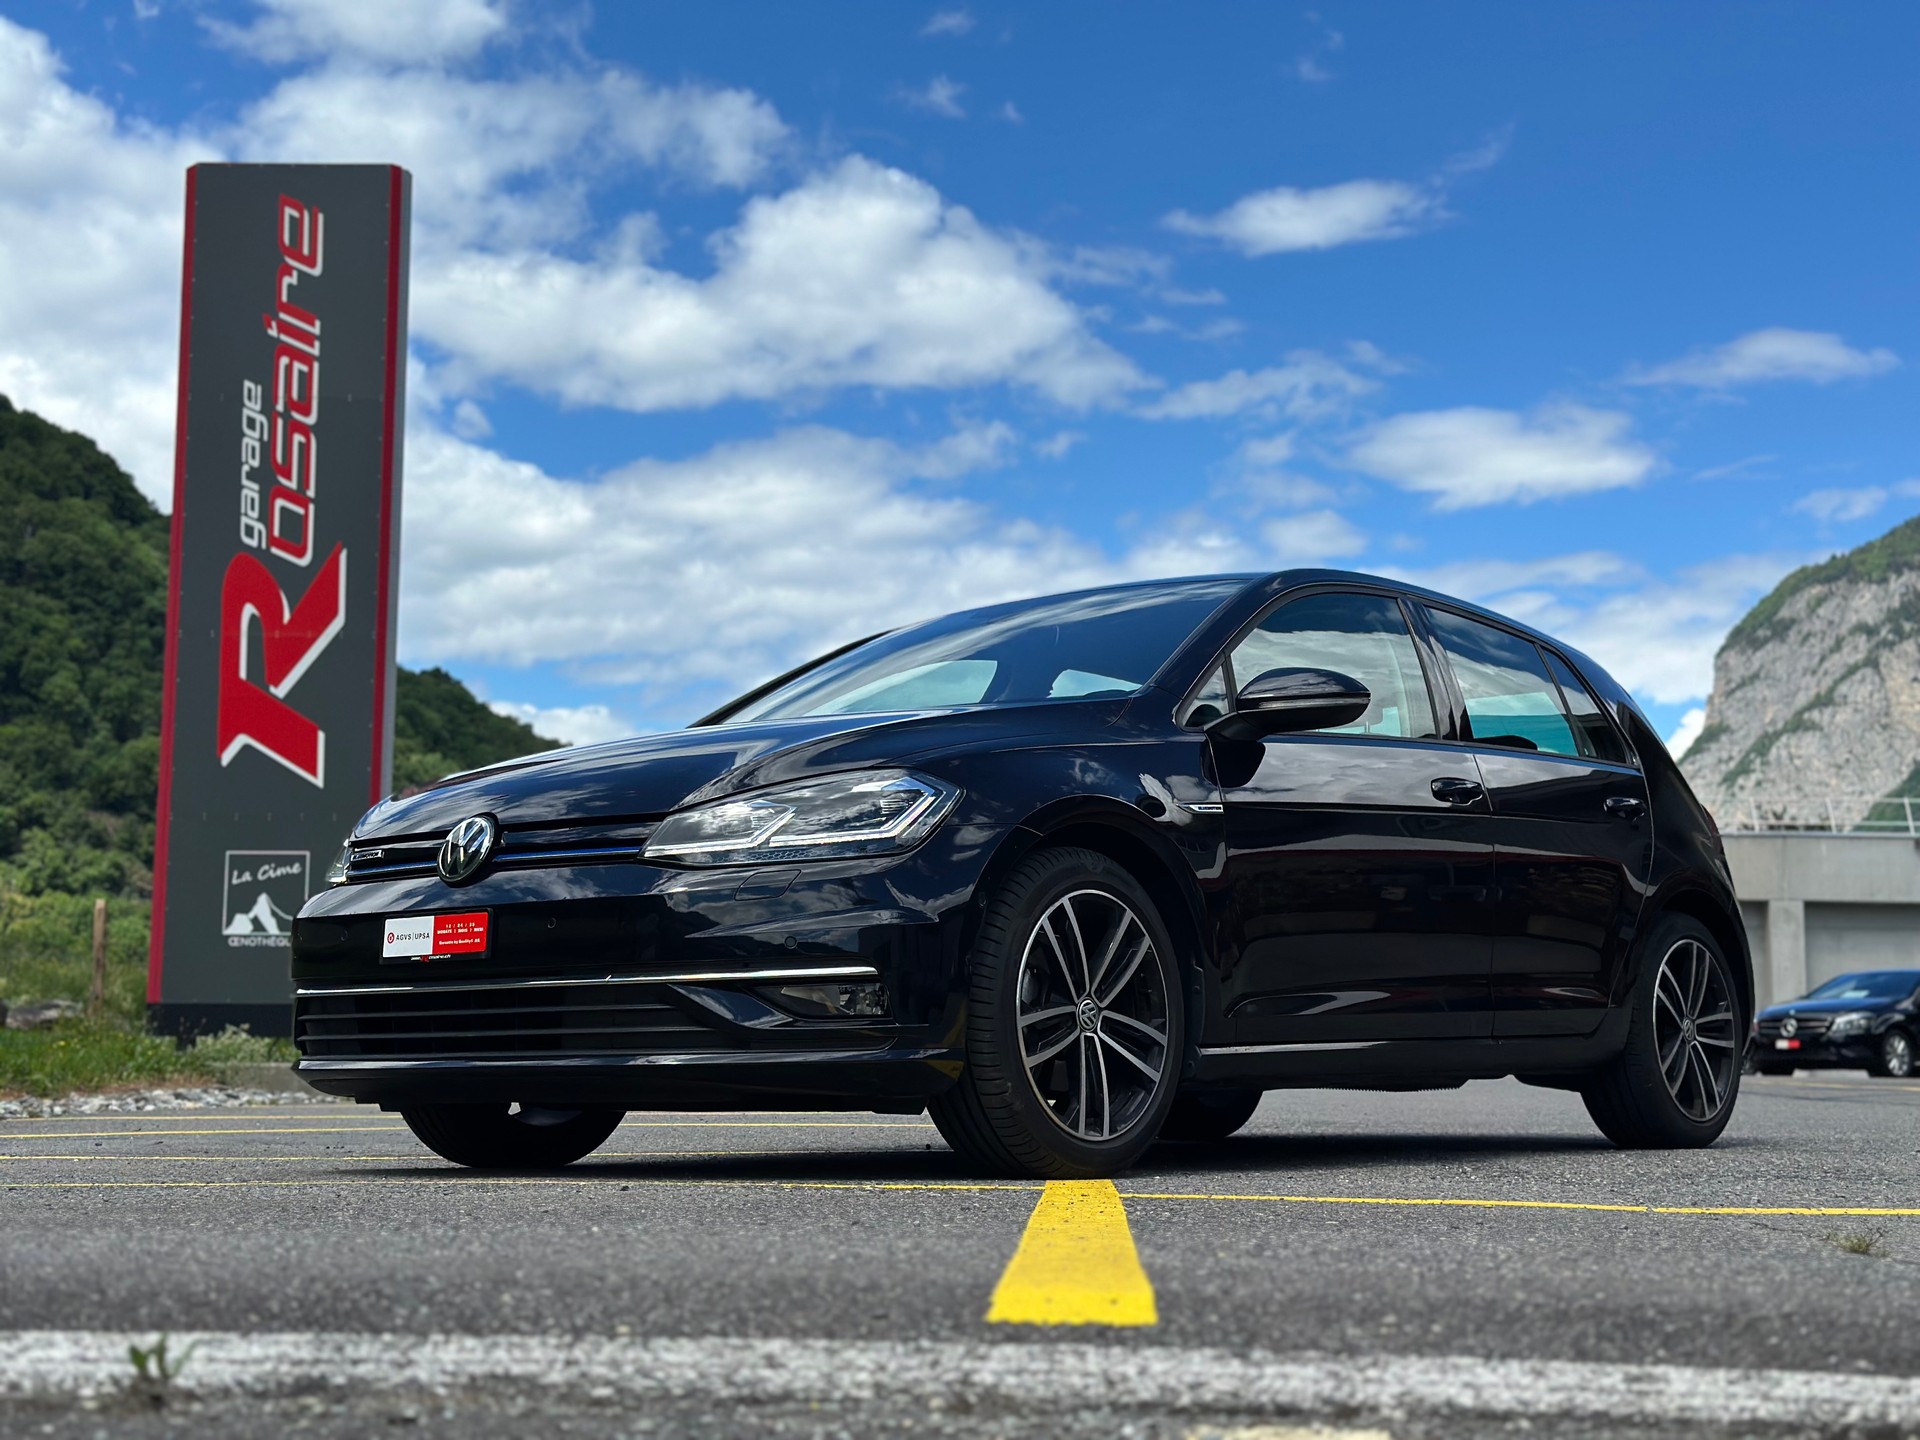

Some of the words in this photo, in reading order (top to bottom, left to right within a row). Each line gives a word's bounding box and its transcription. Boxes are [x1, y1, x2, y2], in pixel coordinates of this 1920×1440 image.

[240, 379, 268, 549] garage
[231, 869, 253, 885] La
[257, 862, 302, 880] Cime
[396, 933, 412, 941] AGVS
[414, 932, 430, 940] UPSA
